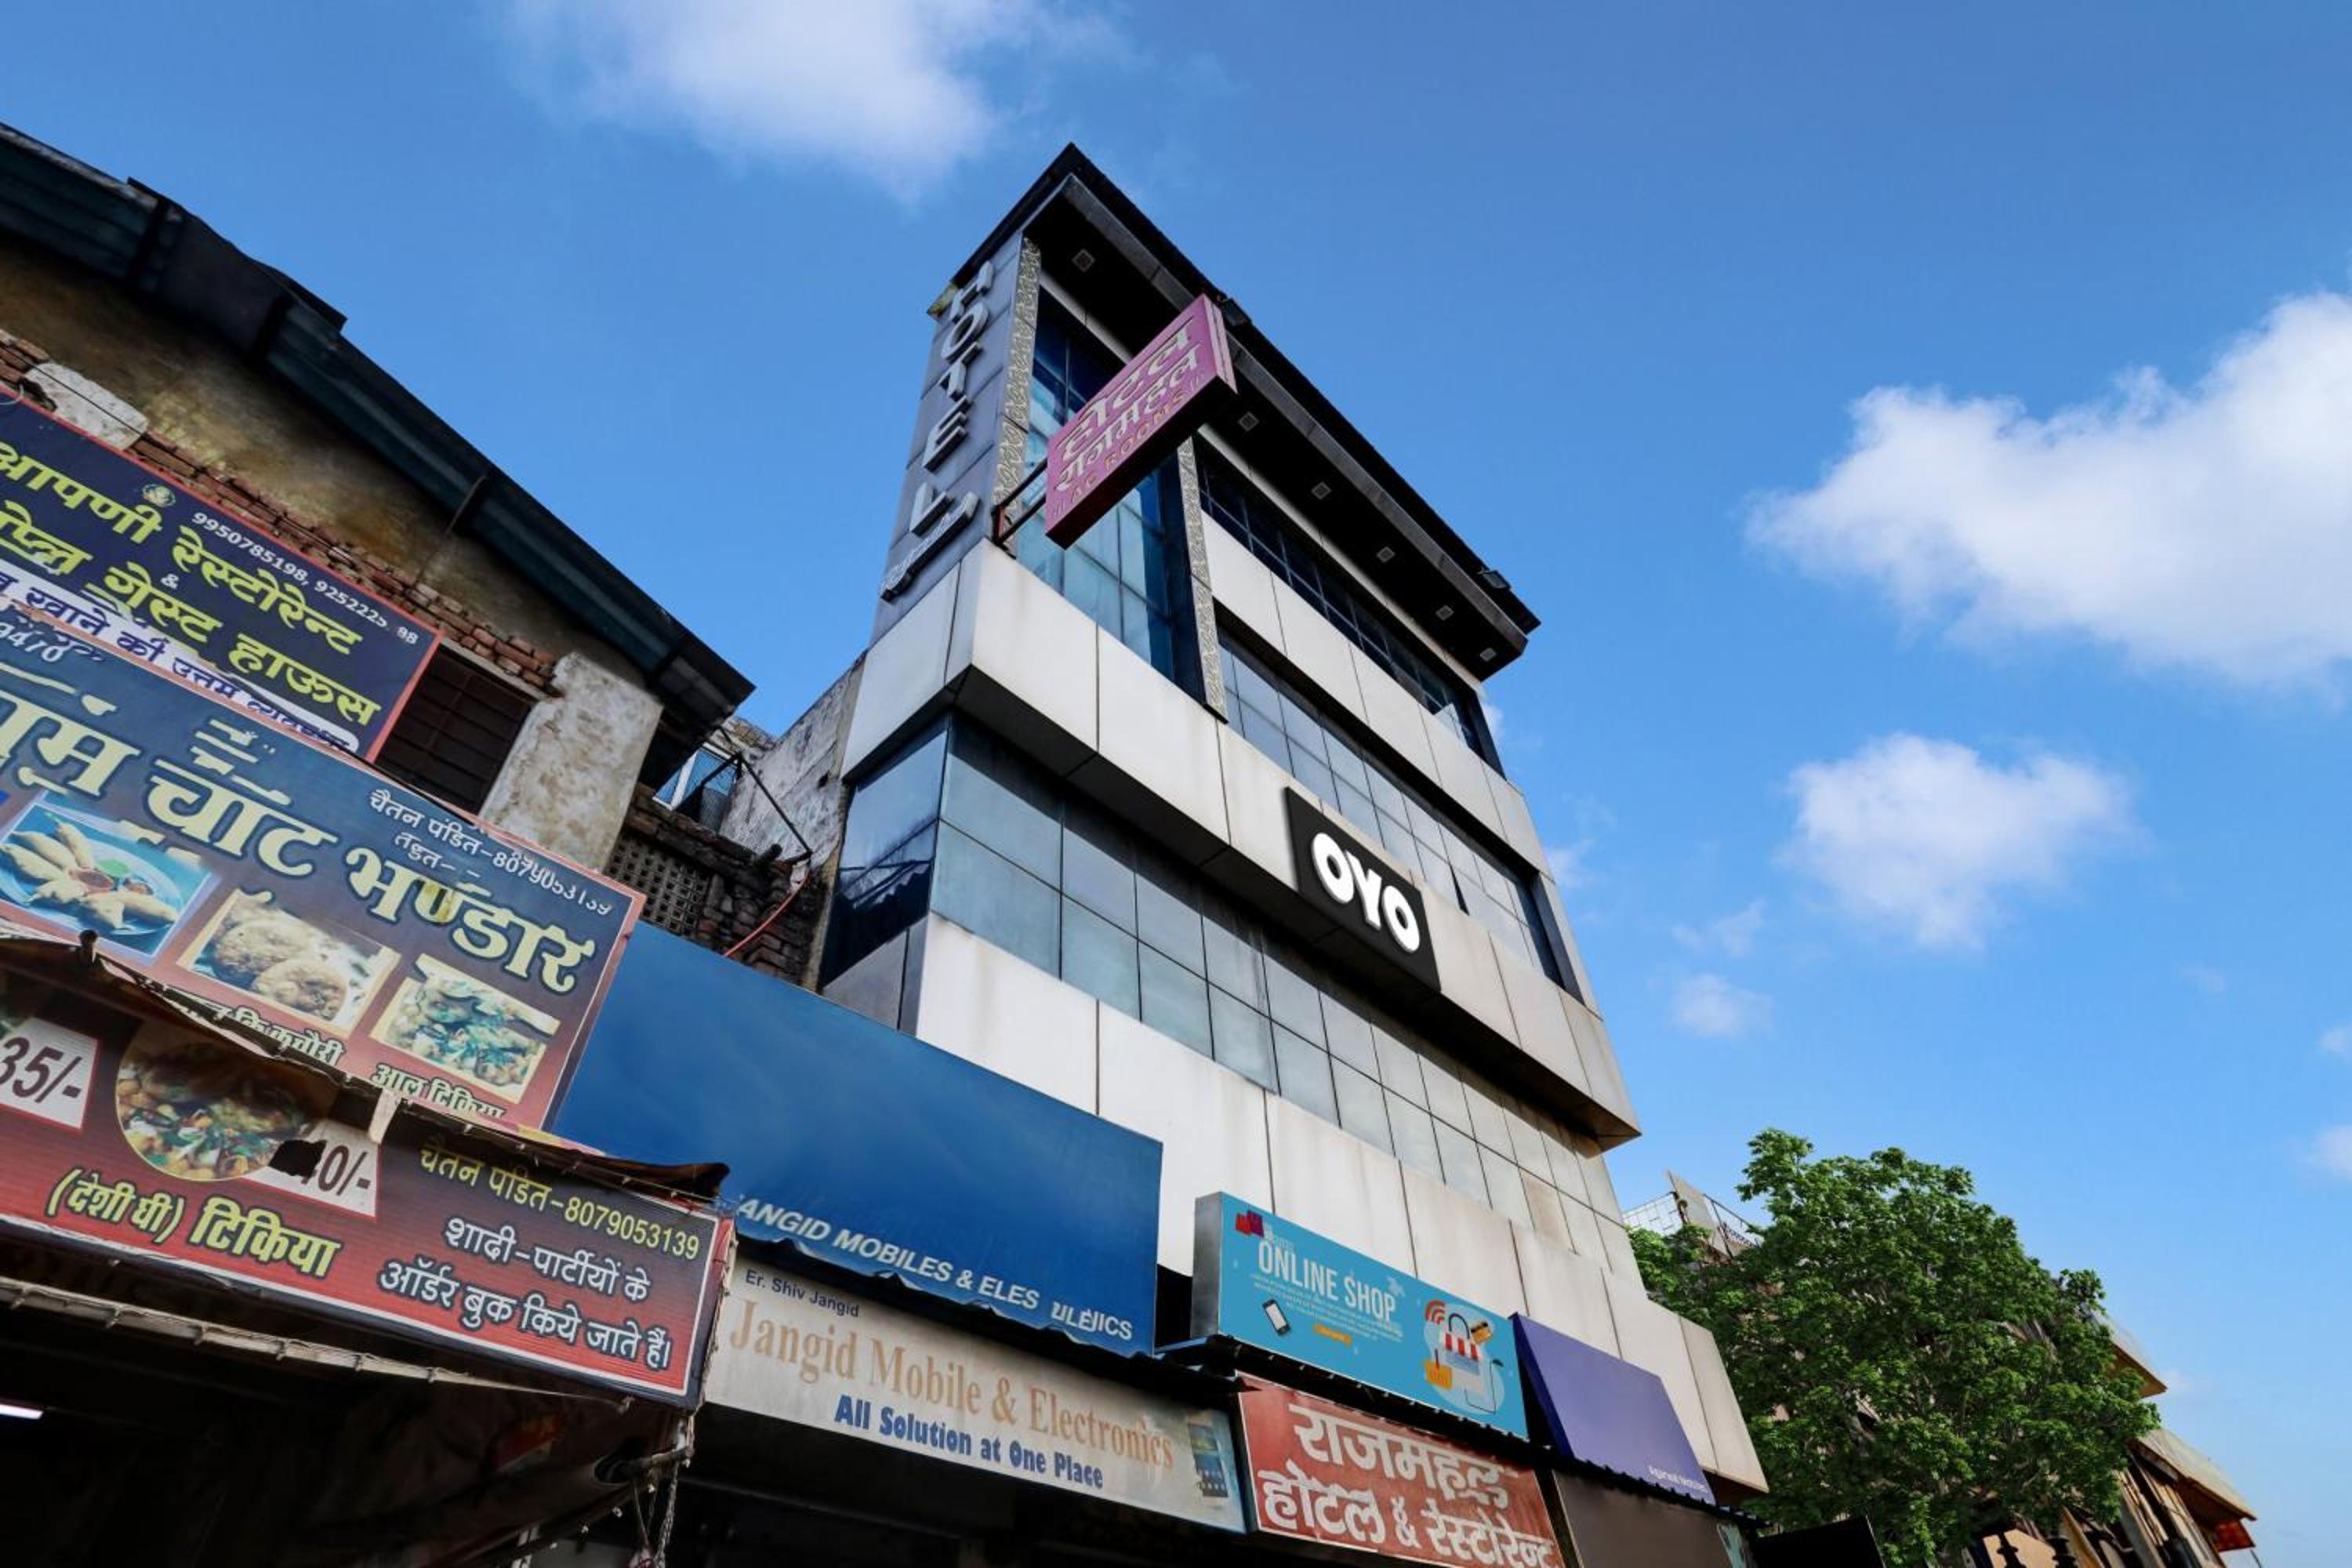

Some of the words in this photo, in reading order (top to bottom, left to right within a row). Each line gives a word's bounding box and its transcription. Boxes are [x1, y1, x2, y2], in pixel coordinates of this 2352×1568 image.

[908, 260, 994, 539] HOTEL
[1054, 315, 1193, 462] होटल
[160, 573, 180, 590] &
[346, 847, 595, 993] भण्डार
[300, 1145, 372, 1196] 0/-
[190, 1196, 342, 1277] टिकिया
[738, 1197, 831, 1241] ANGID
[832, 1228, 953, 1283] MOBILES
[956, 1269, 974, 1290] &
[462, 1285, 517, 1329] बुक
[521, 1294, 582, 1343] किये
[587, 1319, 642, 1359] जाते
[624, 1267, 652, 1301] के
[746, 1269, 766, 1288] Er.
[771, 1279, 806, 1300] Shiv
[809, 1291, 861, 1318] Jangid
[1258, 1240, 1339, 1301] ONLINE
[1343, 1275, 1397, 1323] SHOP
[728, 1298, 858, 1385] Jangid
[869, 1338, 982, 1414] Mobile
[992, 1377, 1017, 1425] &
[1029, 1385, 1175, 1469] Electronics
[835, 1394, 871, 1430] All
[880, 1408, 972, 1456] Solution
[981, 1436, 1001, 1463] at
[1009, 1439, 1047, 1474] One
[1054, 1451, 1104, 1489] Place
[1258, 1458, 1386, 1544] होटल
[1390, 1494, 1422, 1550] &
